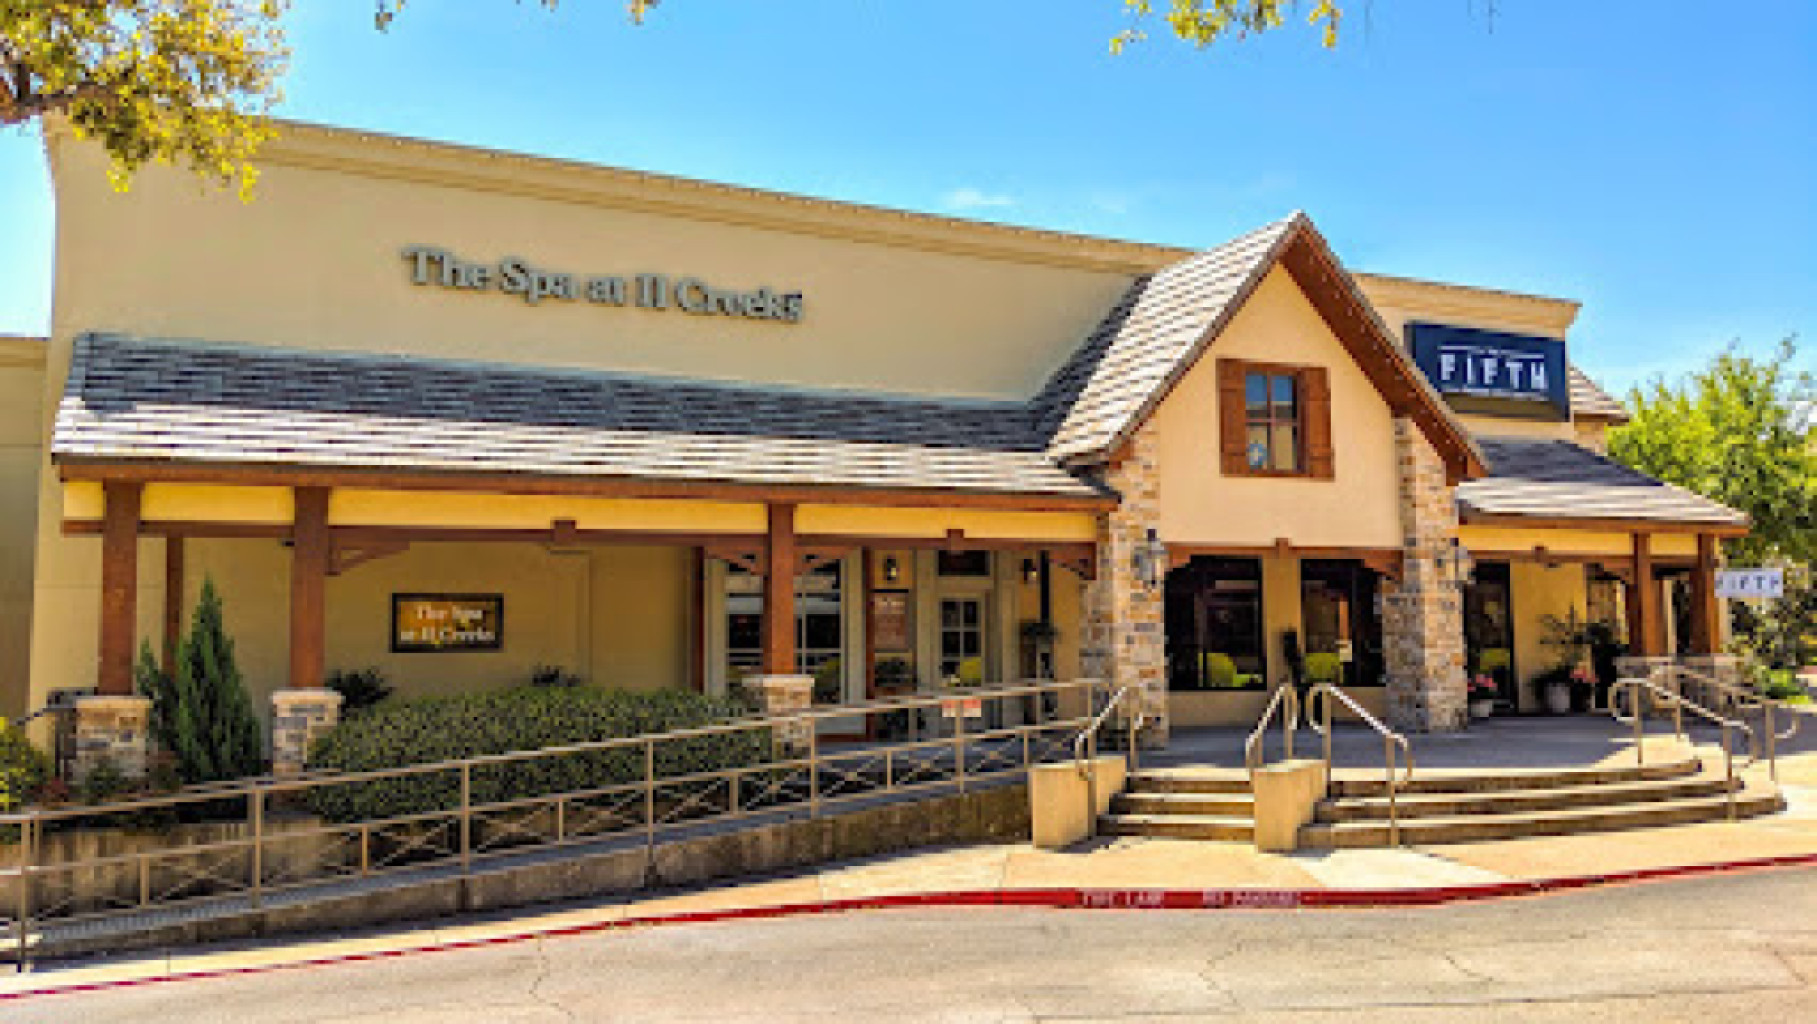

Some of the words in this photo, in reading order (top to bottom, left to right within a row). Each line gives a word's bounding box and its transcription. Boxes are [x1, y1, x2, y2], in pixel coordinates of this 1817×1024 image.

[401, 245, 492, 288] The
[499, 257, 577, 304] Spa
[585, 276, 624, 306] at
[676, 277, 803, 323] Creeks
[1440, 353, 1547, 390] FIFTH
